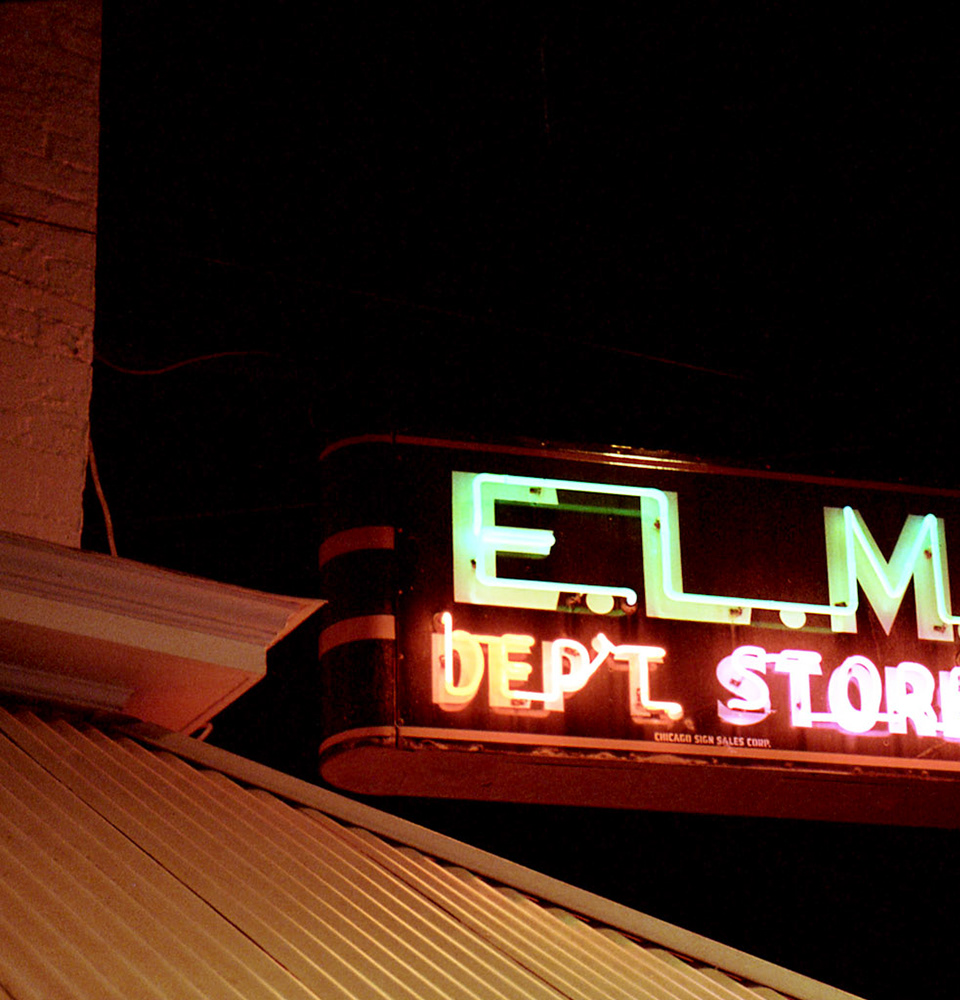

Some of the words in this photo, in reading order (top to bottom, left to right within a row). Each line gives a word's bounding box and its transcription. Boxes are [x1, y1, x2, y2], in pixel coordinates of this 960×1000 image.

[654, 732, 692, 743] CHICAGO
[694, 734, 715, 745] SIGN
[716, 735, 745, 747] SALES
[746, 737, 771, 748] CORP.
